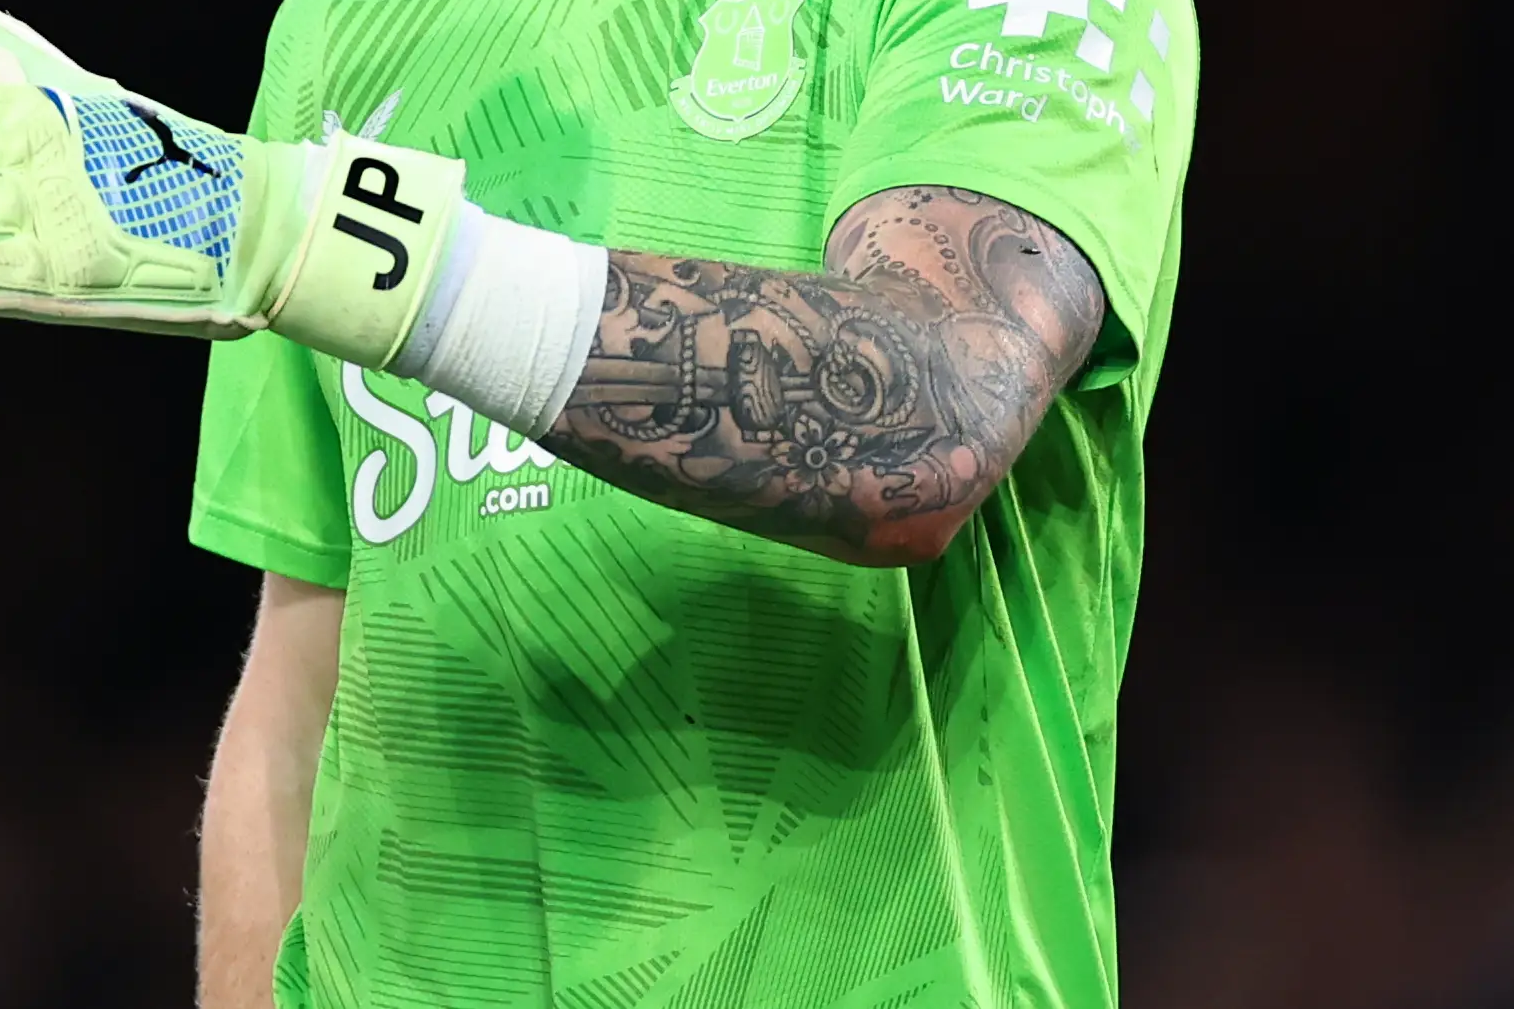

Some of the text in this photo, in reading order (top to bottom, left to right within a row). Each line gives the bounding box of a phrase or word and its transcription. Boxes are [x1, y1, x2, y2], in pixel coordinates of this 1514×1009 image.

[706, 72, 778, 97] Everton
[940, 75, 1049, 123] Ward
[949, 42, 1141, 154] Christoph
[332, 155, 425, 292] JP
[479, 482, 551, 519] .com
